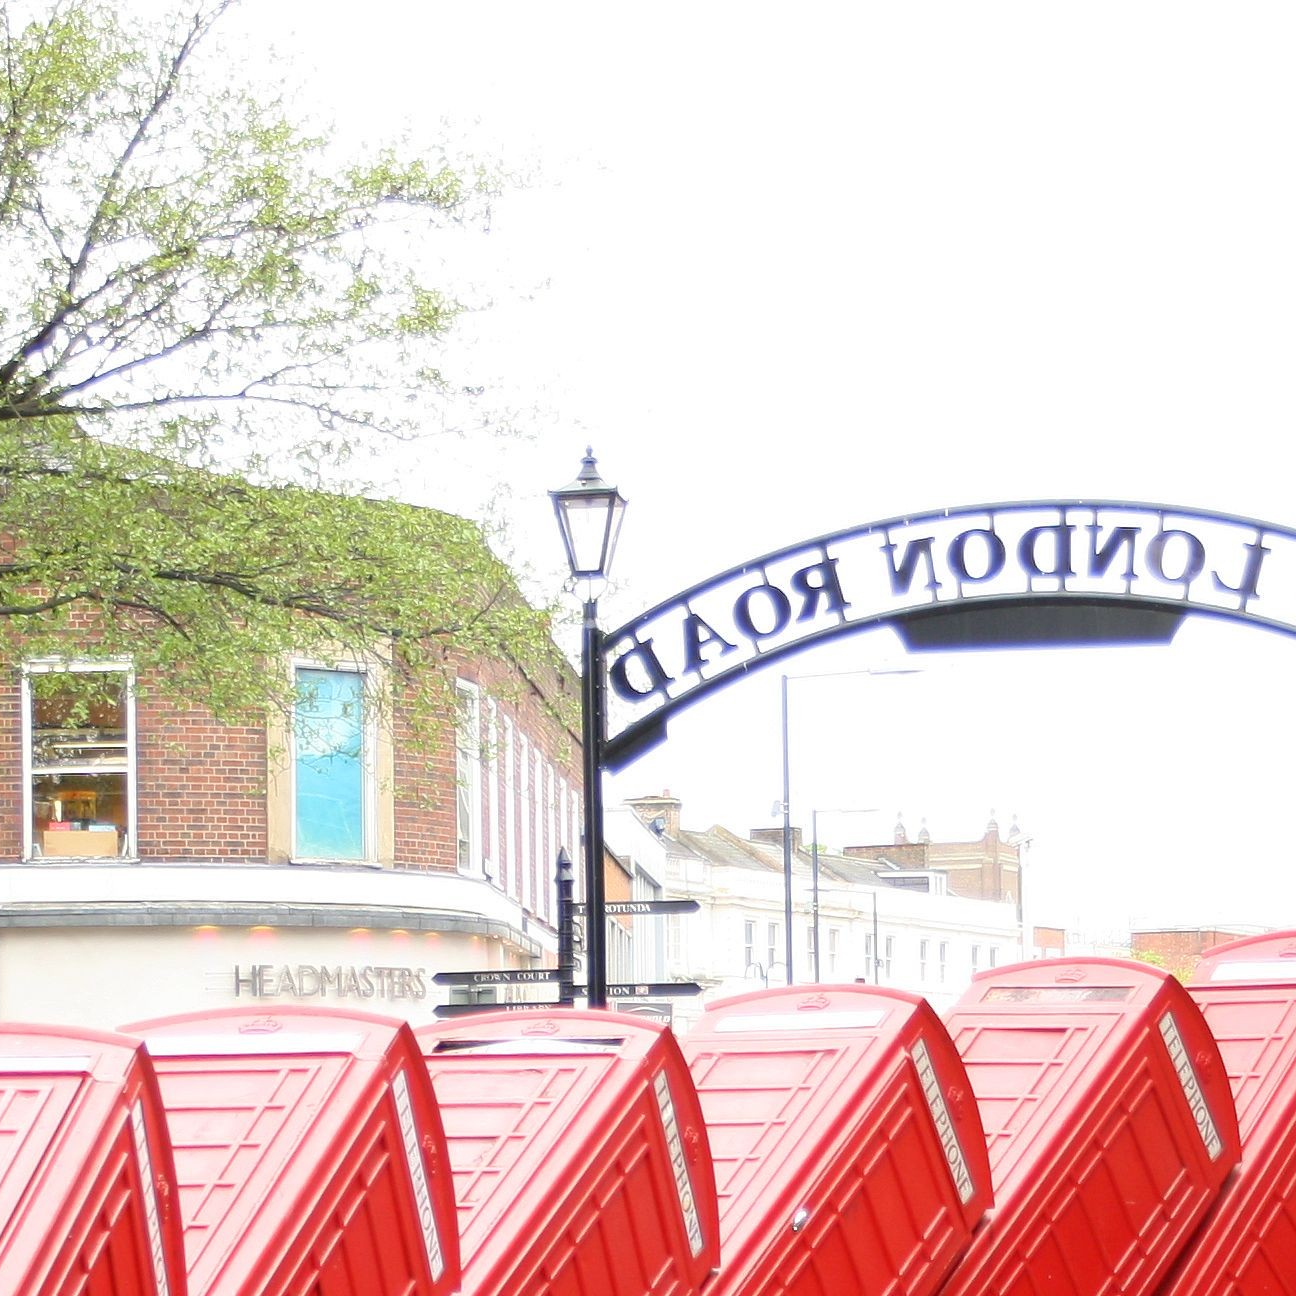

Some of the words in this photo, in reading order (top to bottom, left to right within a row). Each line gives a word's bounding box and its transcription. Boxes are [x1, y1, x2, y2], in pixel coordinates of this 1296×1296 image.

[234, 964, 427, 1000] HEADMASTERS
[473, 972, 511, 982] CROWN
[517, 971, 551, 981] COURT
[915, 1047, 971, 1197] TELEPHONE
[1163, 1017, 1220, 1157] TELEPHONE
